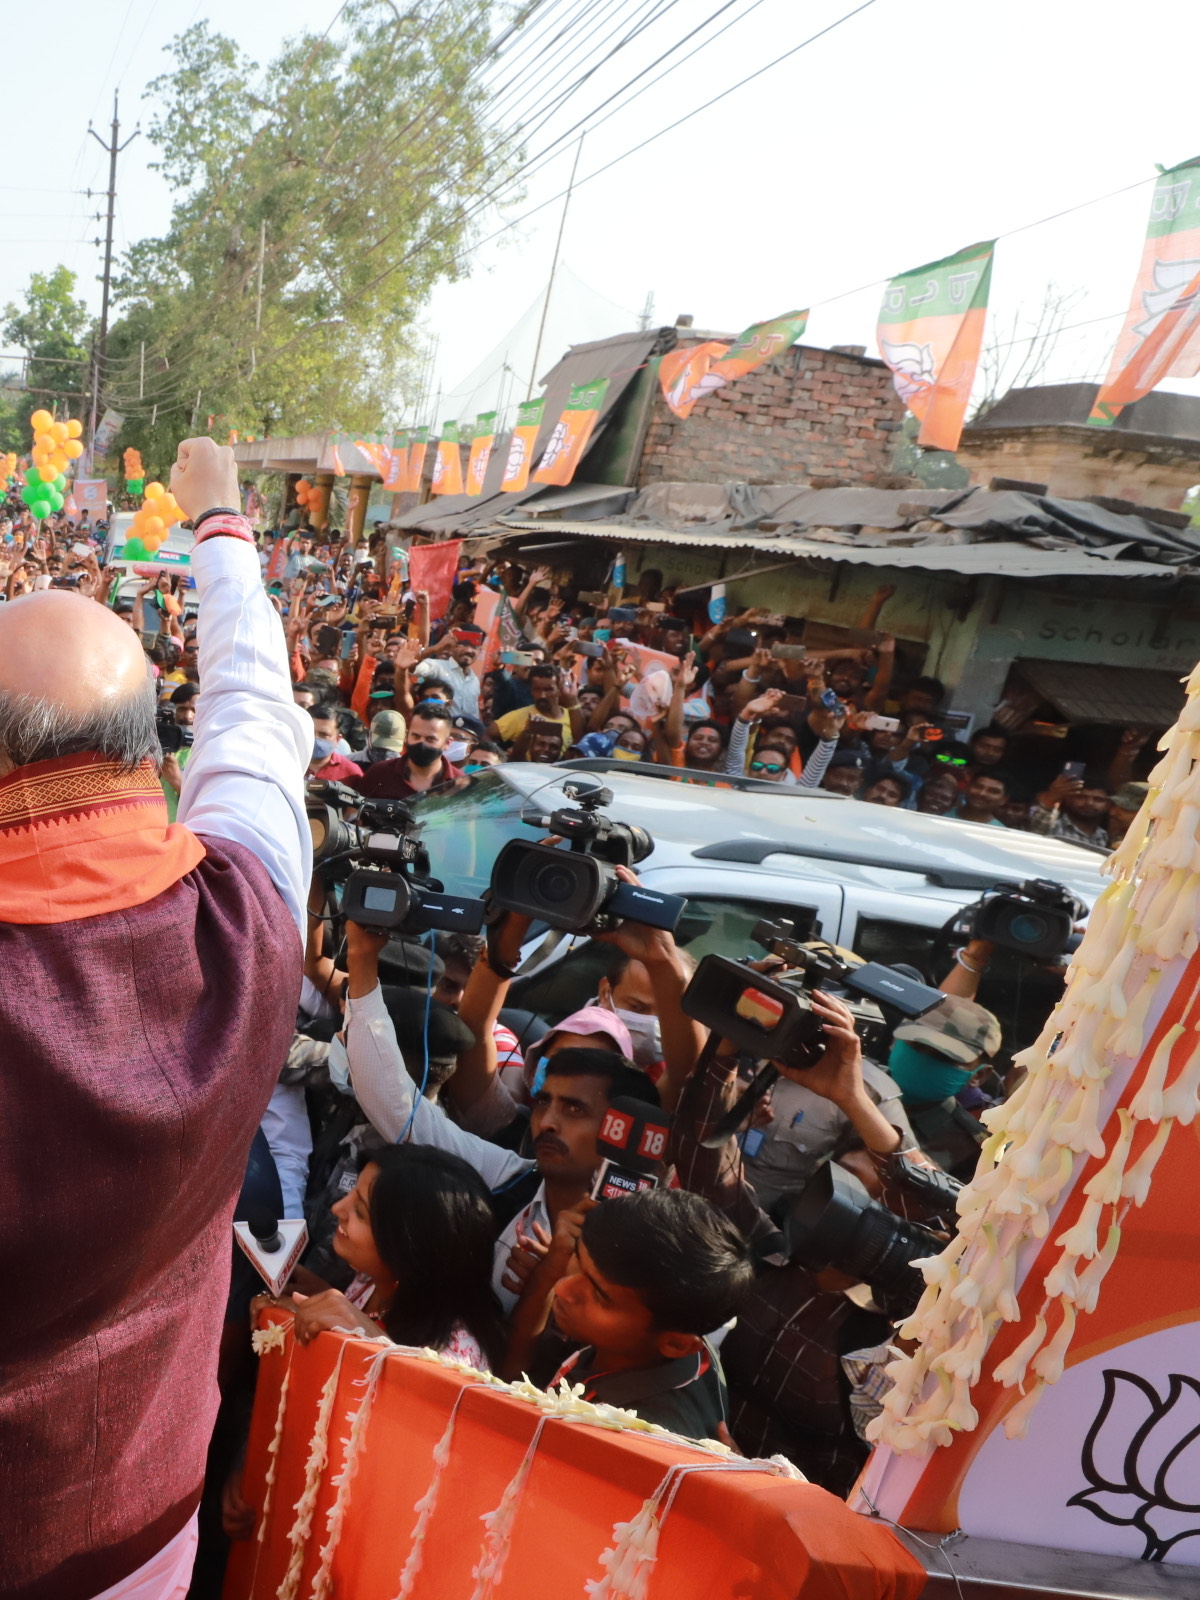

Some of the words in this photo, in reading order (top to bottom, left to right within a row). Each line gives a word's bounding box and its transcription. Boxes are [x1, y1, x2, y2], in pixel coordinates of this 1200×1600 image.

[159, 552, 180, 560] POLICE
[632, 891, 665, 904] Panasonic
[451, 907, 465, 915] 4K
[603, 1114, 625, 1140] 18
[644, 1130, 665, 1155] 18
[609, 1175, 637, 1191] NEWS
[638, 1181, 648, 1190] 18
